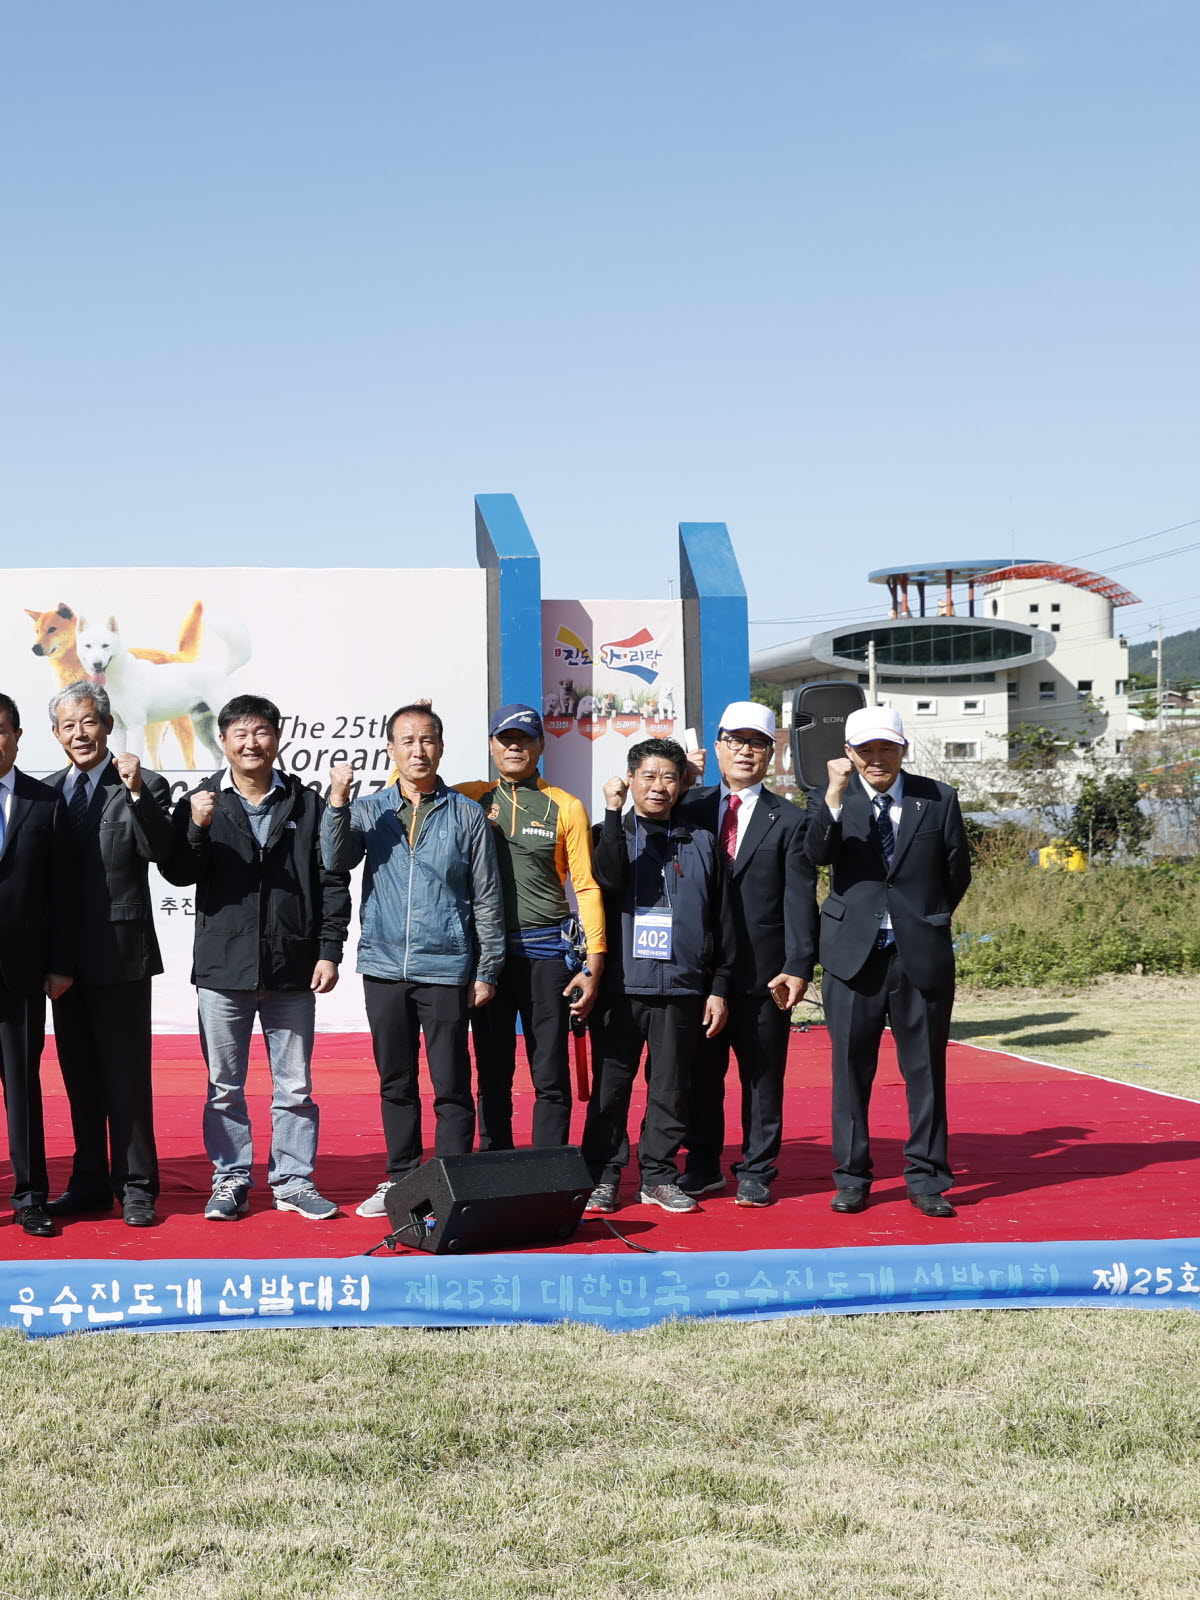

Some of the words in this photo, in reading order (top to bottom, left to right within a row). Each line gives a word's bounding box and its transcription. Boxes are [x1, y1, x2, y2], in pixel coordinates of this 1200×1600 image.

[279, 715, 325, 738] The
[637, 929, 669, 949] 402
[9, 1278, 203, 1327] 우수진도개
[218, 1273, 370, 1317] 선발대회
[403, 1274, 521, 1312] 제25회
[541, 1269, 690, 1318] 대한민국
[706, 1265, 896, 1311] 우수진도개
